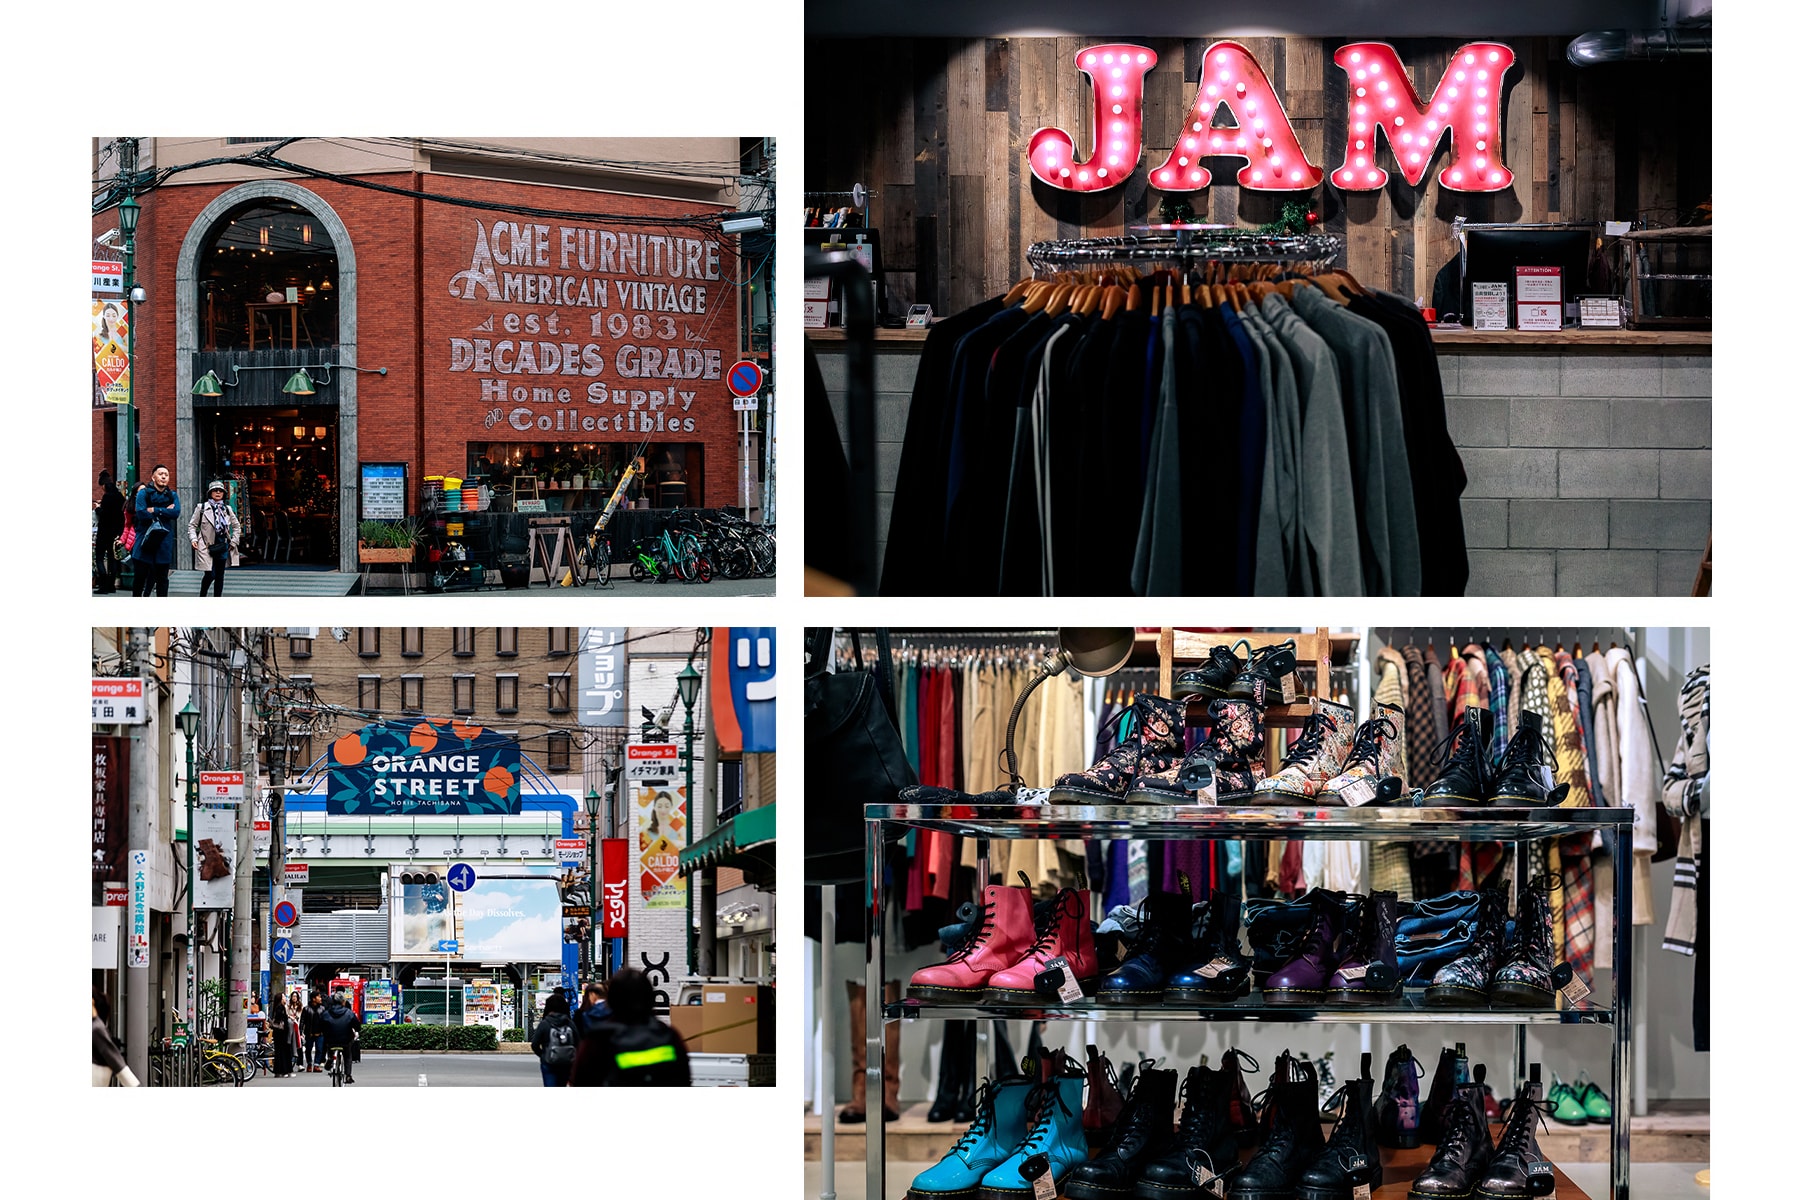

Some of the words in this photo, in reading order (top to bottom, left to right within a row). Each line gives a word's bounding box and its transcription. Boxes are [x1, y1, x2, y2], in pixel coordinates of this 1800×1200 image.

[1025, 40, 1516, 192] JAM
[453, 218, 551, 288] ACME
[560, 226, 720, 281] FURNITURE
[614, 280, 707, 314] VINTAGE
[503, 310, 571, 335] est.
[590, 311, 678, 340] 1983
[101, 357, 125, 368] CALDO
[448, 337, 605, 377] DECADES
[615, 344, 722, 380] GRADE
[480, 378, 571, 403] Home
[587, 381, 697, 412] Supply
[508, 406, 696, 433] Collectibles
[126, 683, 140, 693] St.
[631, 748, 662, 758] Orange
[664, 748, 676, 756] St.
[372, 755, 480, 773] ORANGE
[202, 775, 230, 784] Orange
[374, 779, 480, 796] STREET
[648, 856, 679, 868] CALDO
[134, 870, 145, 935] 大野記念病院
[469, 908, 484, 919] Day
[487, 908, 526, 918] Dissolves.
[1533, 1165, 1550, 1173] JAM
